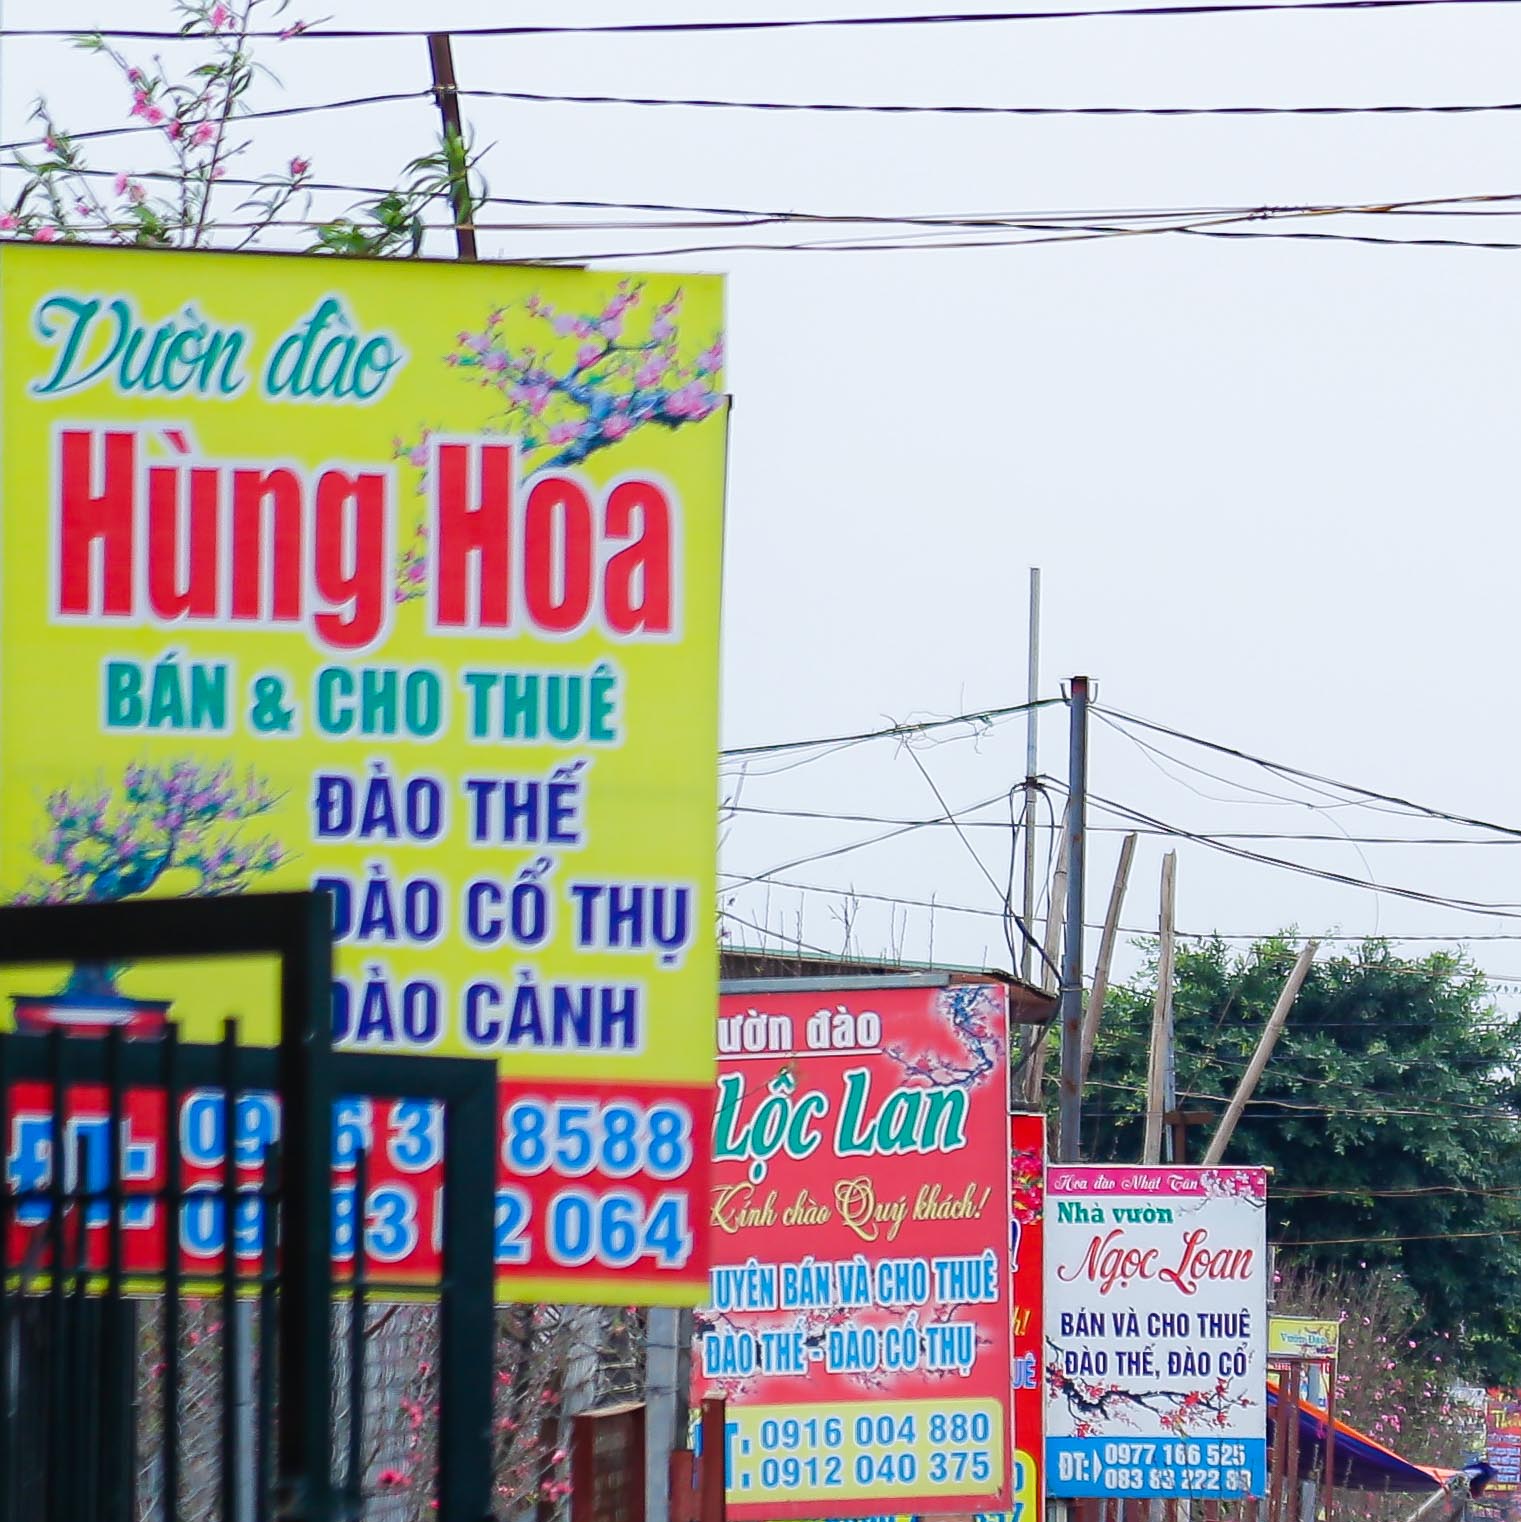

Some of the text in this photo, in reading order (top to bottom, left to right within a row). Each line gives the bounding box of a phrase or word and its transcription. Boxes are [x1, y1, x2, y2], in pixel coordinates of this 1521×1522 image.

[264, 295, 403, 401] đào
[58, 428, 674, 650] Hùng Hoa
[104, 652, 620, 743] BÁN & CHO THUÊ
[465, 760, 589, 844] THẾ
[466, 858, 552, 946] CỔ
[572, 884, 690, 966] THỤ
[716, 1005, 883, 1053] ườn đào
[503, 1098, 695, 1180] 8588
[711, 1067, 970, 1184] Lộc Lan
[781, 1190, 832, 1226] chào
[834, 1175, 909, 1242] Quý
[912, 1182, 992, 1222] khách!
[1055, 1173, 1198, 1192] Hoa đào Nhật Tân
[1057, 1201, 1174, 1224] Nhà vườn
[546, 1187, 694, 1270] 064
[1057, 1228, 1159, 1295] Ngọc
[1158, 1228, 1254, 1295] Loan
[711, 1247, 1000, 1312] UYÊN BÁN VÀ CHO THUÊ
[702, 1327, 756, 1380] ĐÀO
[760, 1315, 809, 1376] THẾ
[825, 1322, 880, 1374] ĐÀO
[881, 1311, 922, 1372] CỔ
[923, 1322, 978, 1378] THỤ
[1060, 1306, 1106, 1338] BÁN
[1111, 1306, 1141, 1338] VÀ
[1147, 1312, 1190, 1338] CHO
[1196, 1307, 1251, 1339] THUÊ
[1065, 1341, 1249, 1380] ĐÀO THẾ, ĐÀO CỔ
[760, 1418, 843, 1451] 0916
[854, 1415, 917, 1449] 004
[927, 1411, 991, 1444] 880
[1058, 1443, 1246, 1482] ĐT: 0977 166 525
[760, 1456, 843, 1489] 0912
[854, 1452, 917, 1486] 040
[928, 1450, 991, 1483] 375
[1104, 1468, 1144, 1490] 083
[1181, 1469, 1220, 1490] 222
